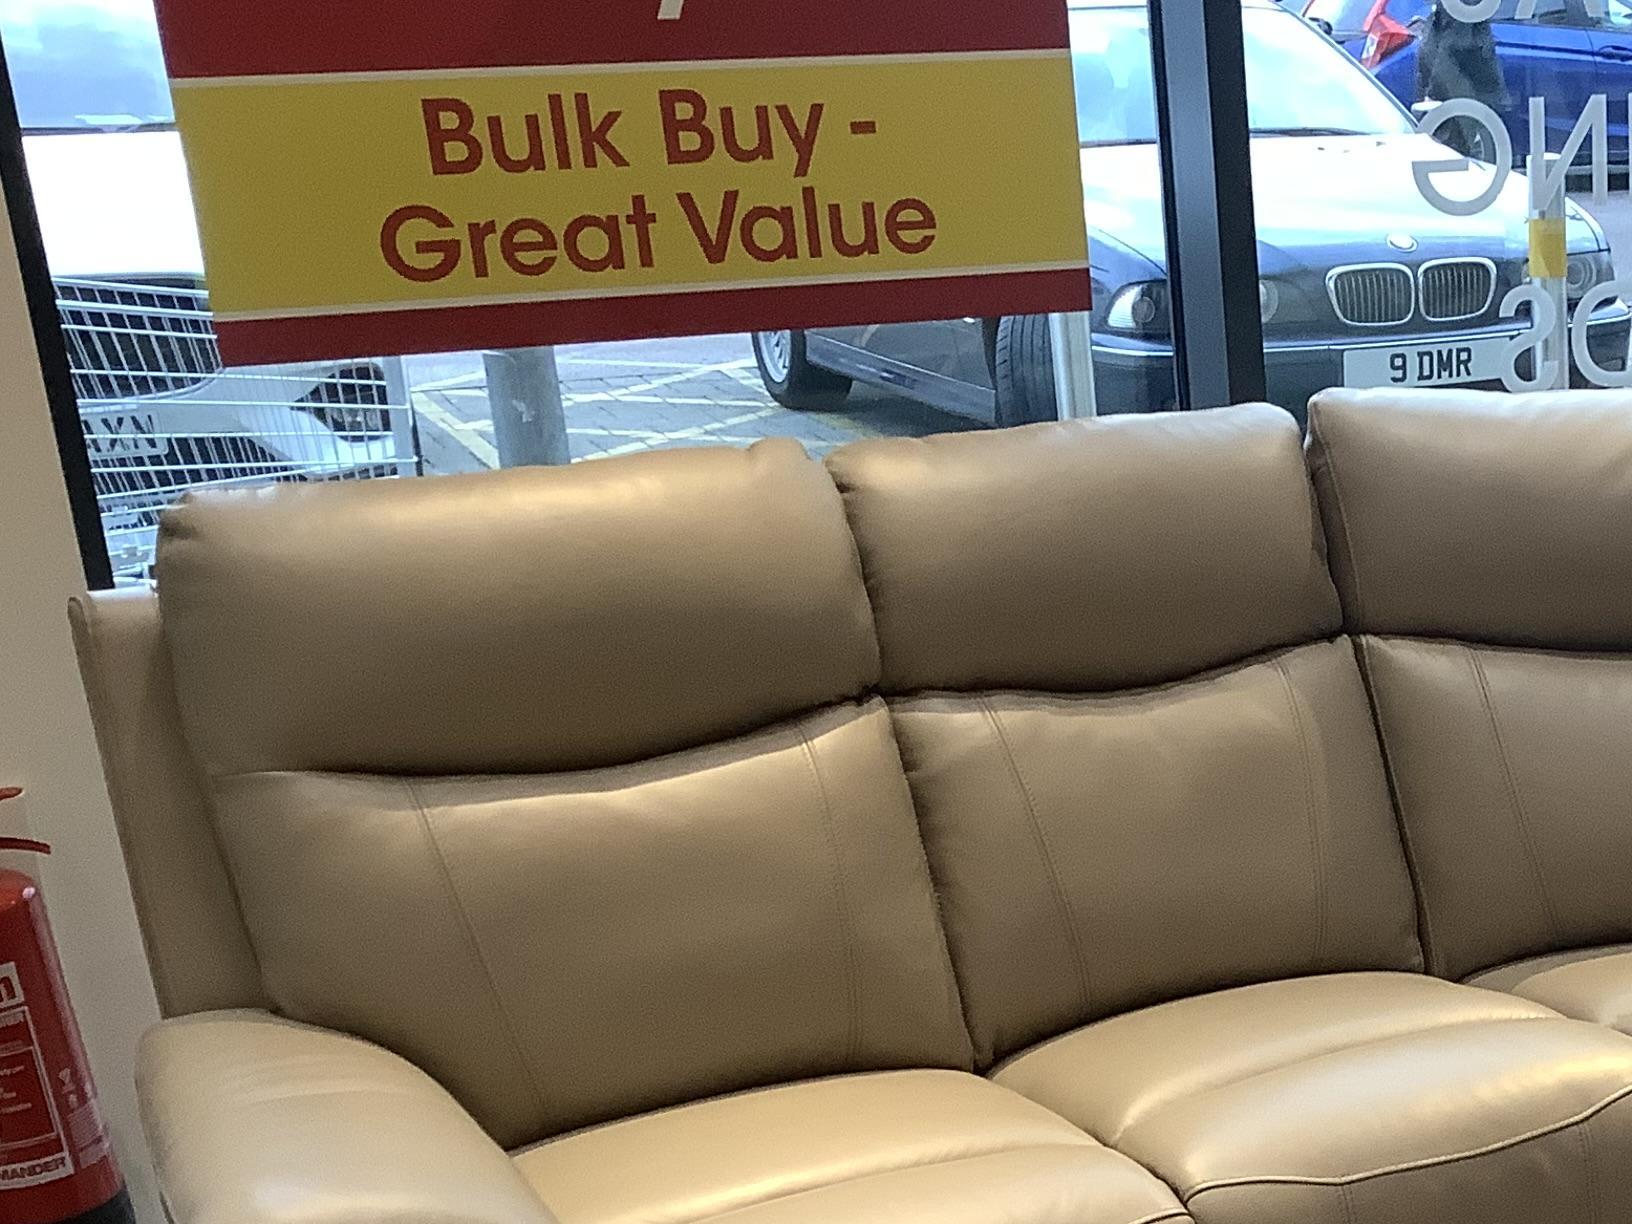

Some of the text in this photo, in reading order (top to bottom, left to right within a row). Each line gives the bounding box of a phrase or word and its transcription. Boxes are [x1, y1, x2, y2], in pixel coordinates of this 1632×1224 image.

[420, 88, 878, 178] Bulk Buy -
[379, 186, 938, 284] Great Value
[1389, 346, 1473, 384] 9 DMR
